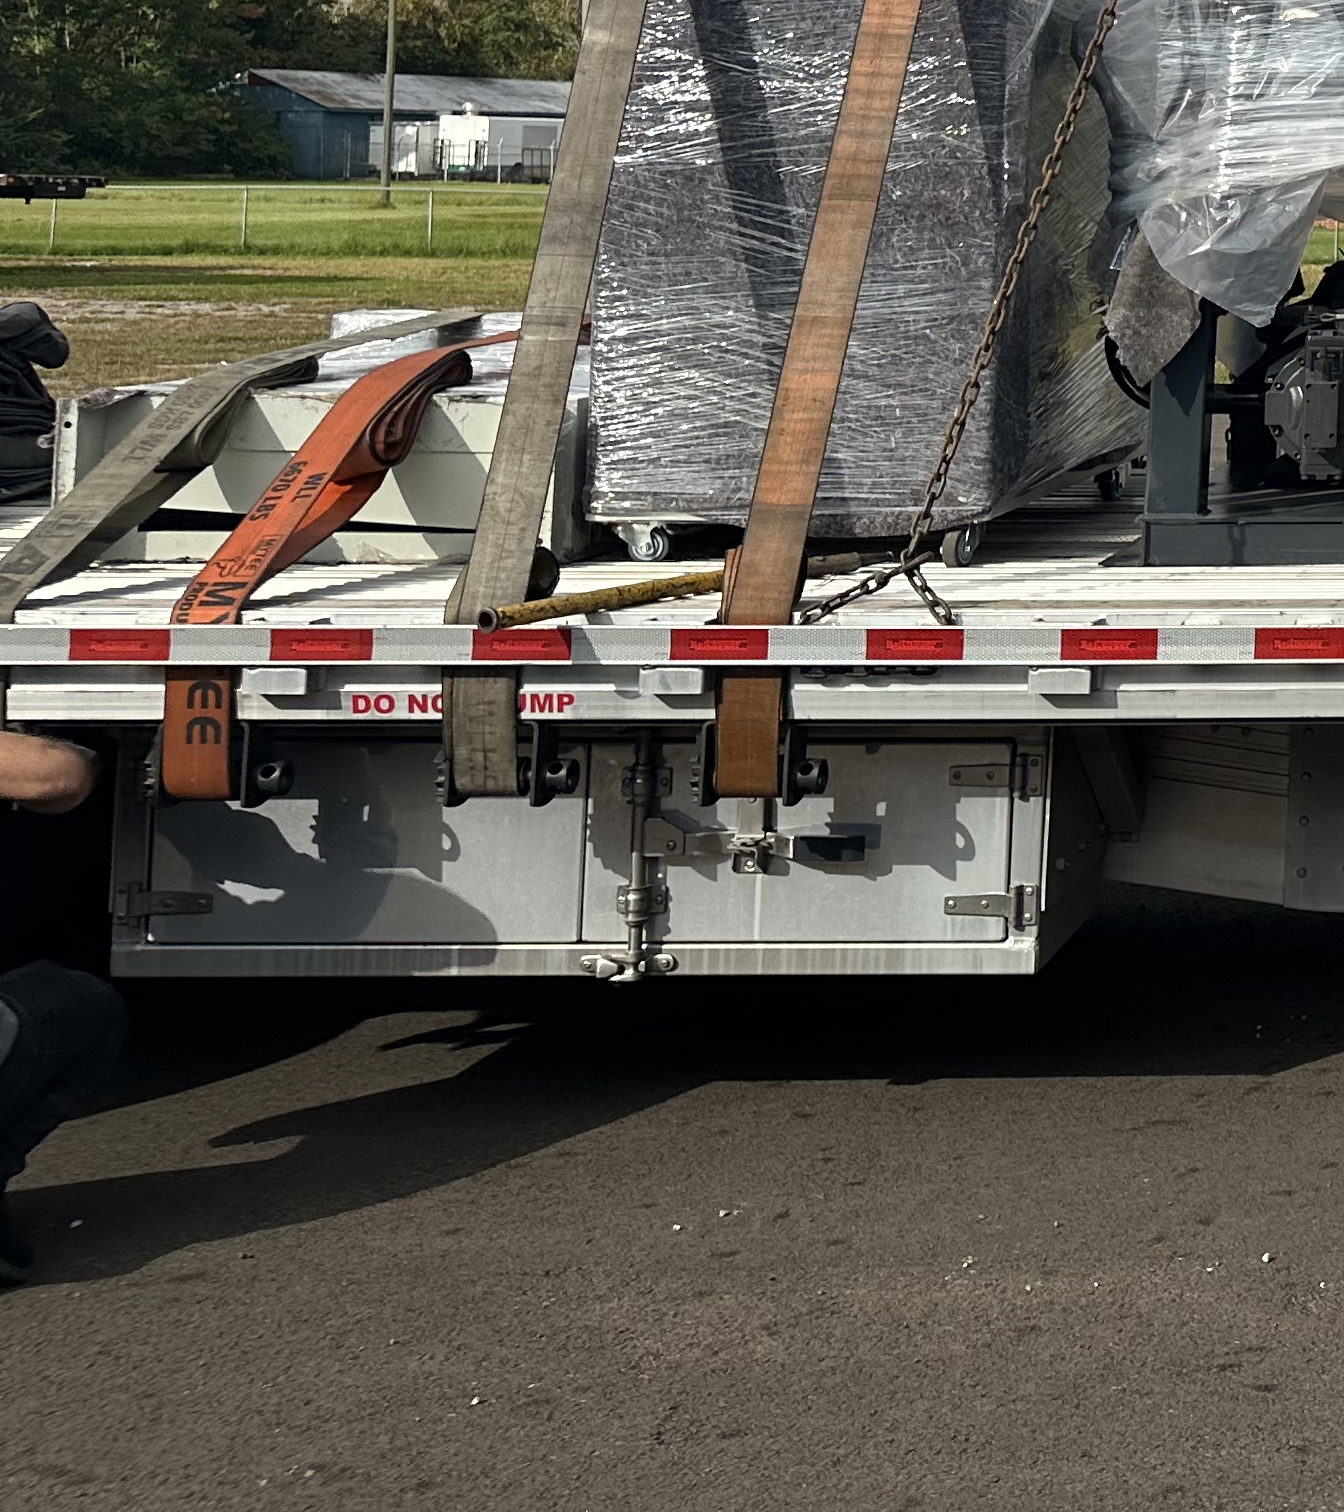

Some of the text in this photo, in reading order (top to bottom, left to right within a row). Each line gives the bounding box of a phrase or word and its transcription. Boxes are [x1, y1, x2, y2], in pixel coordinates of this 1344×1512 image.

[291, 472, 329, 503] WLL
[249, 494, 283, 521] LBS
[352, 694, 395, 714] DO
